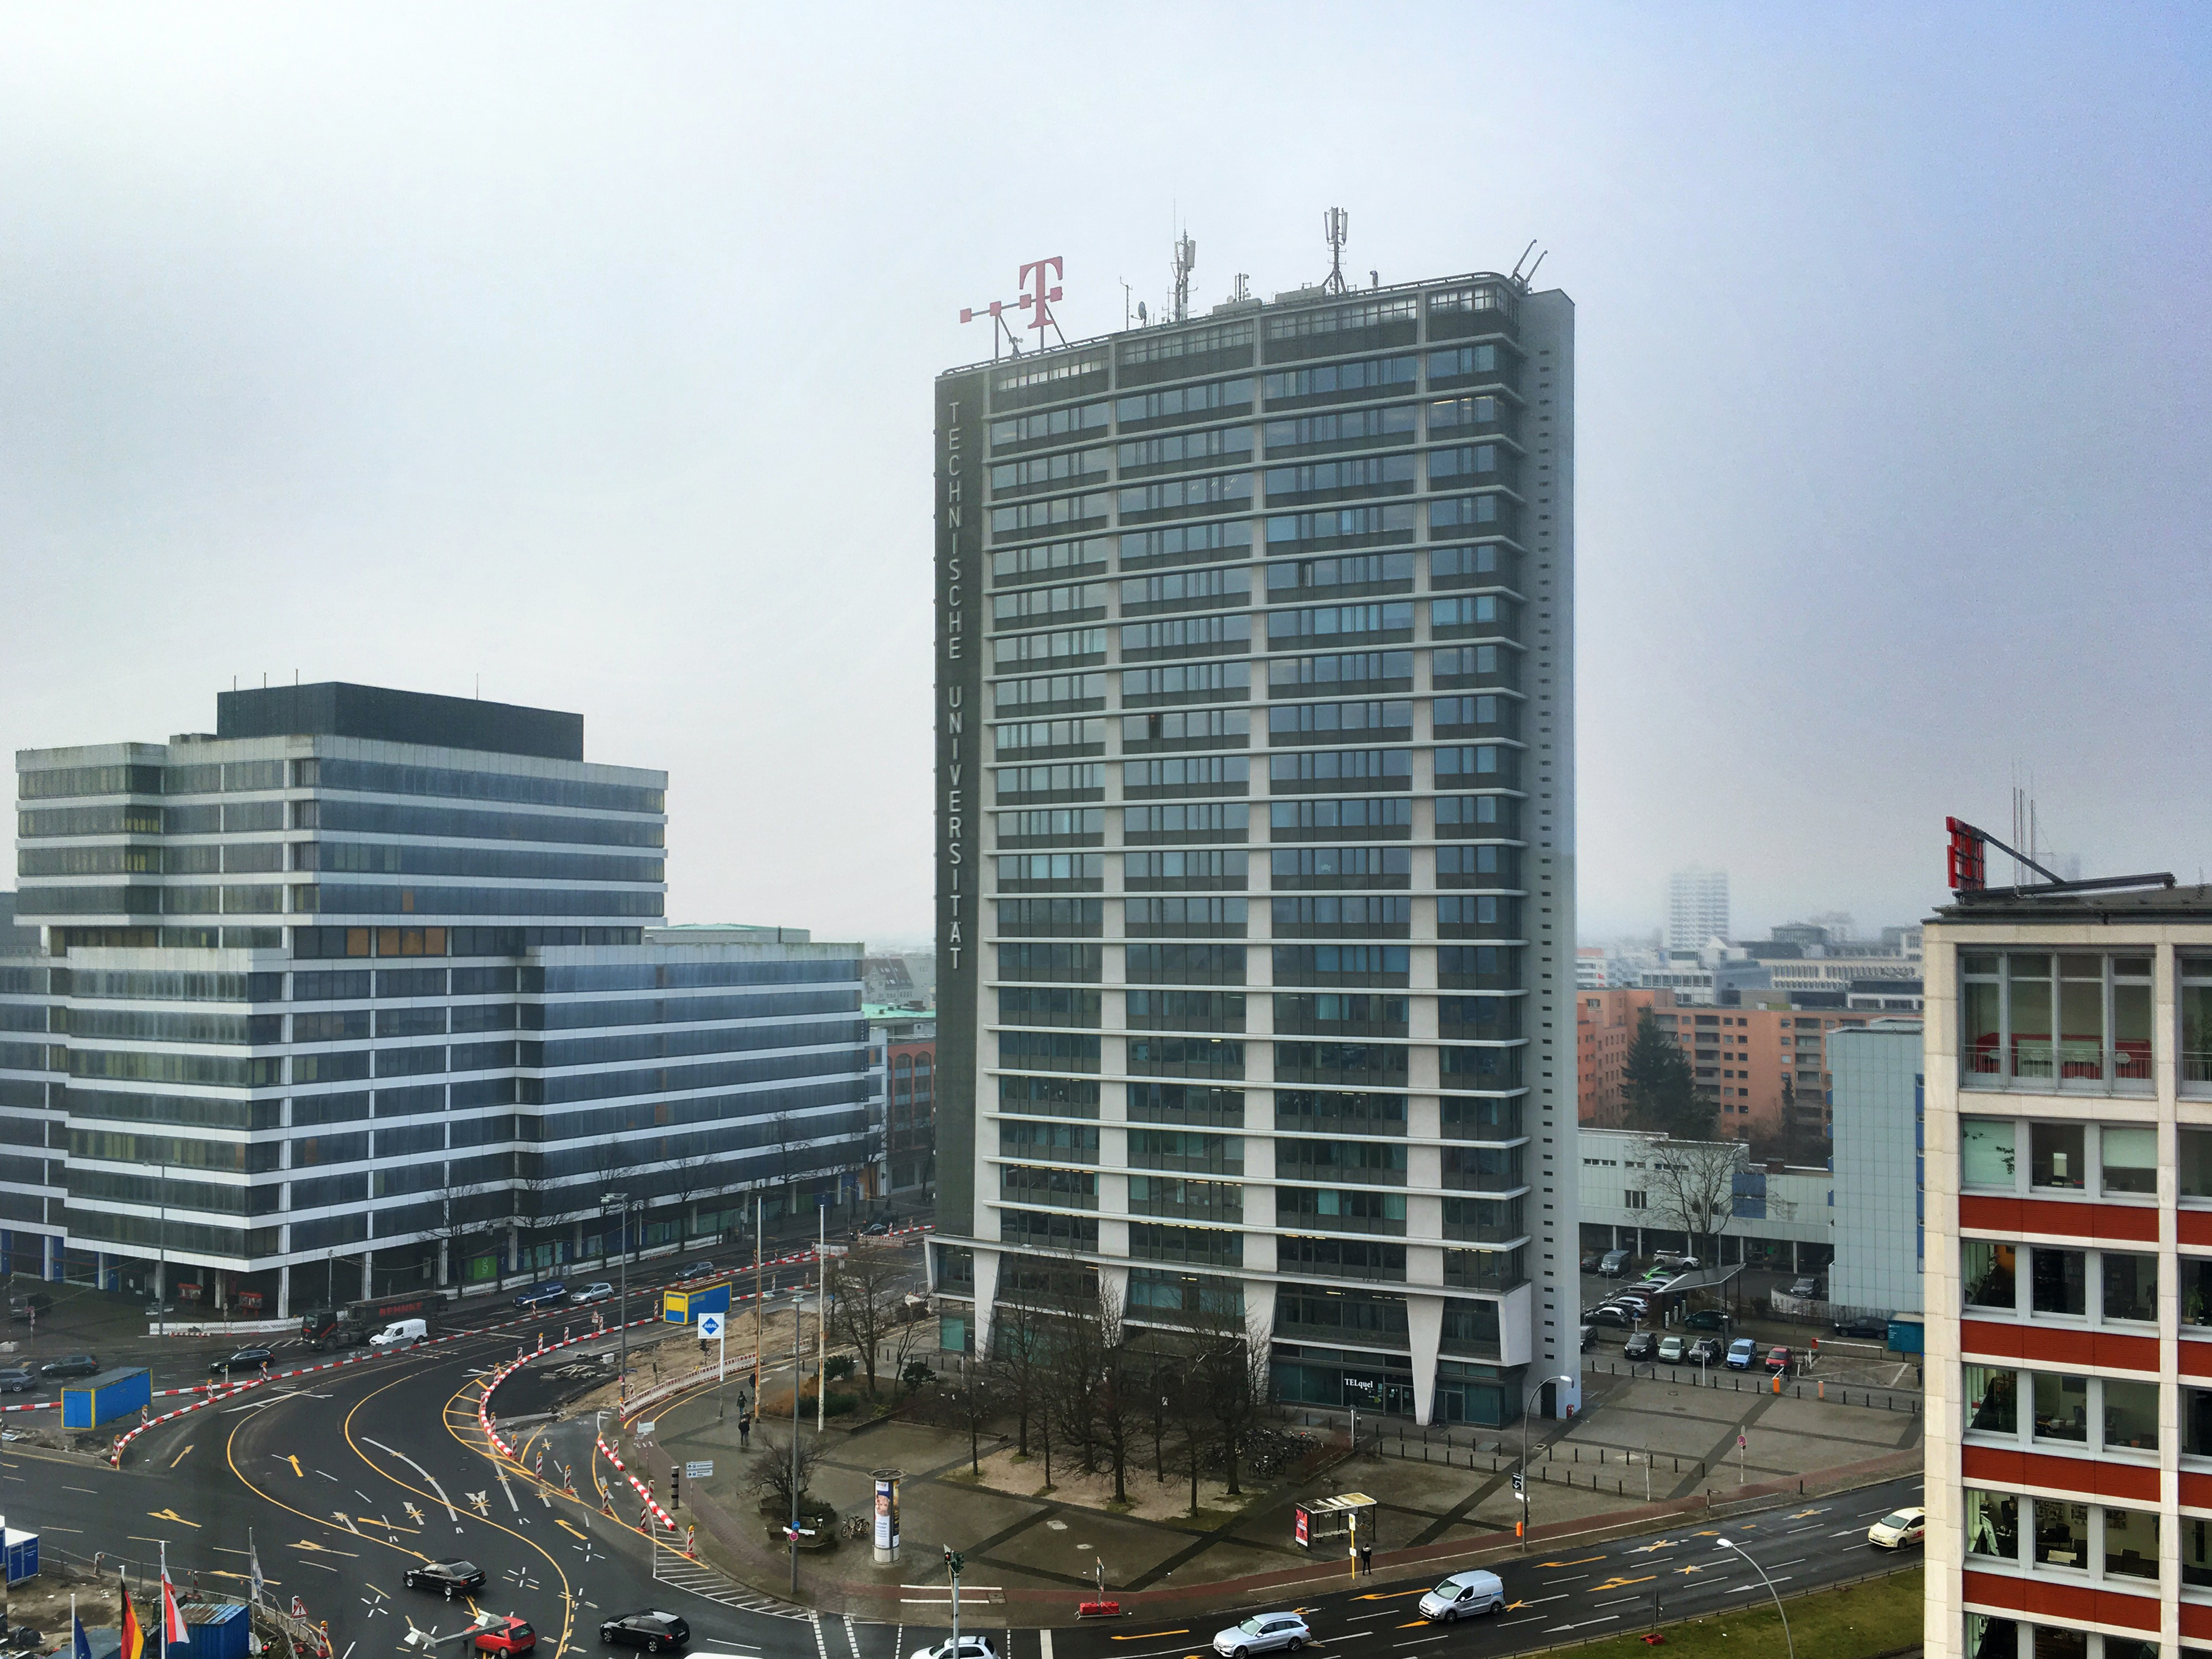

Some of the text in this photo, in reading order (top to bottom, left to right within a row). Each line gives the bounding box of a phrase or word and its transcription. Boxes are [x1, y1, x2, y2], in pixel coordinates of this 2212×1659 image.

[1019, 256, 1063, 329] T
[948, 401, 962, 969] TECHNISCHE UNIVERSITÄT
[1344, 1378, 1373, 1389] TELquel
